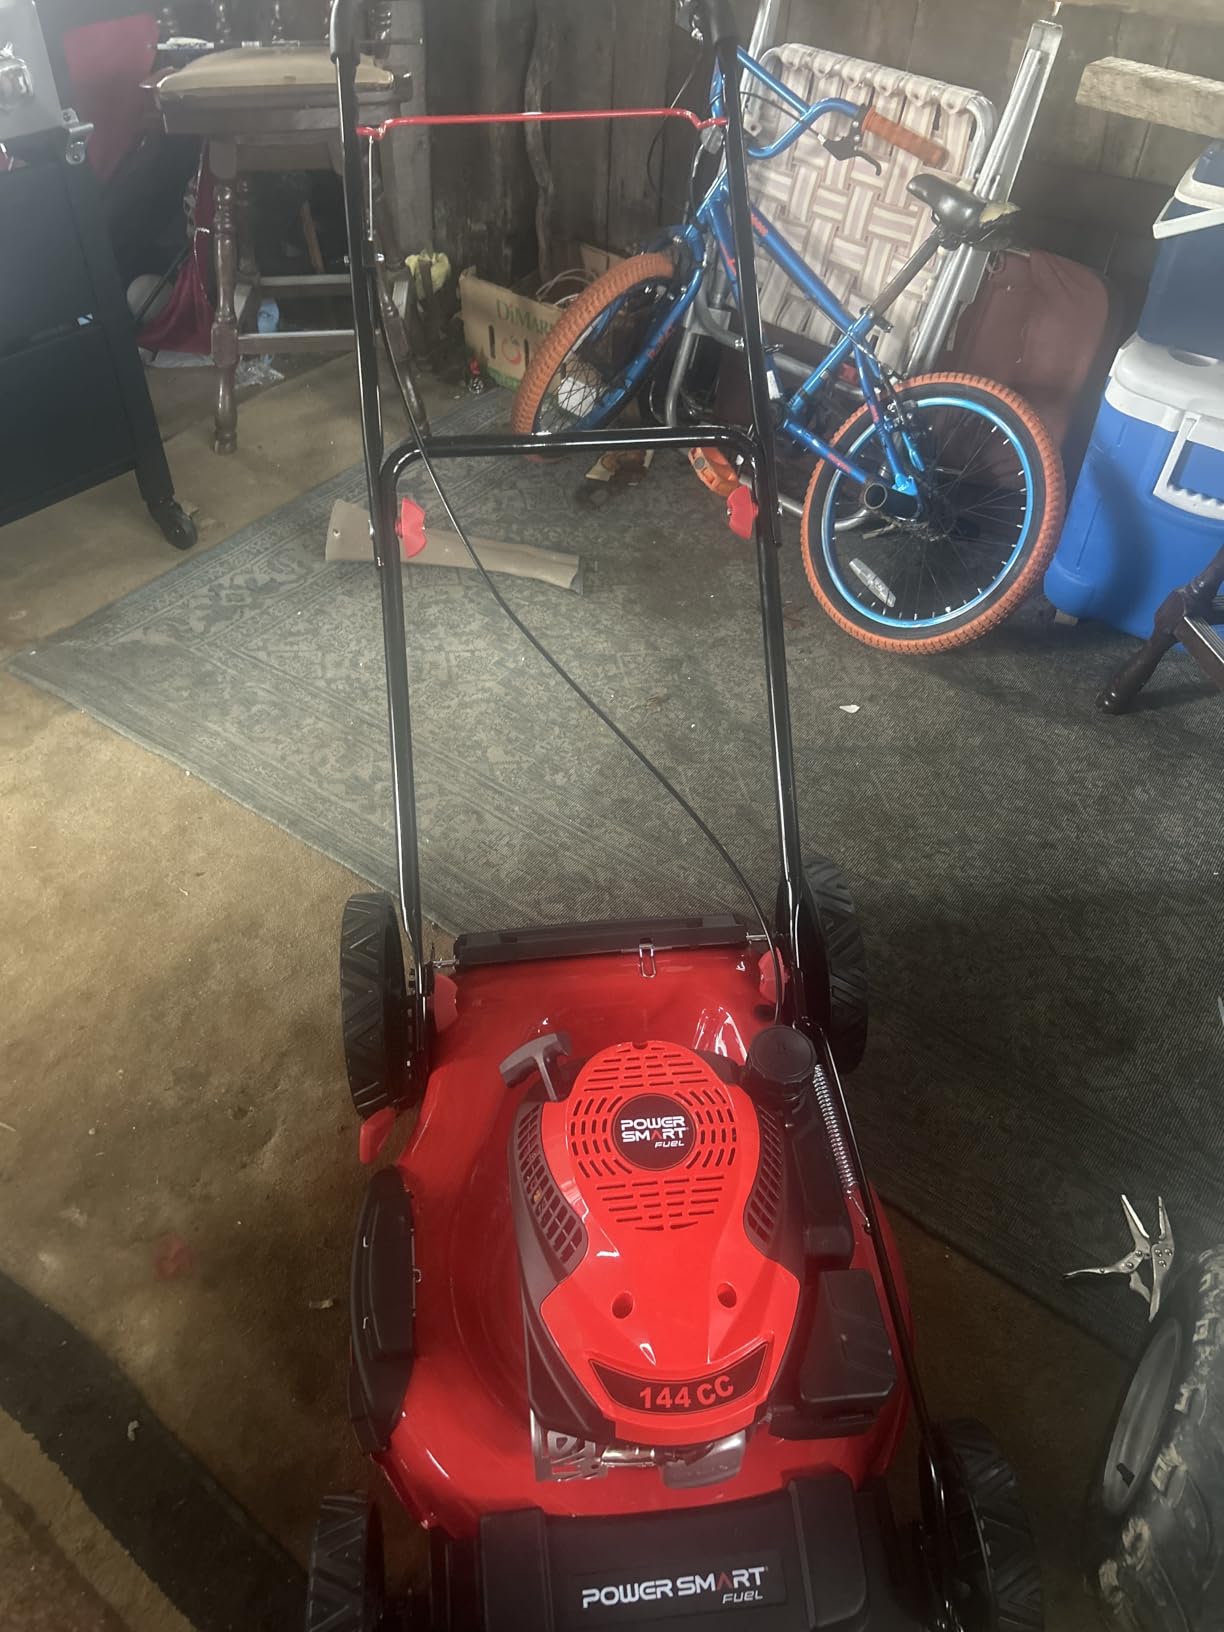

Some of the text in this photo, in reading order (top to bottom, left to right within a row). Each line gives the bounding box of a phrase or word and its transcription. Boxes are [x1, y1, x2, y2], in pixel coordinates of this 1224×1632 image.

[620, 1116, 686, 1131] POWER
[621, 1127, 686, 1143] SMART
[654, 1140, 685, 1149] FUEL
[640, 1375, 734, 1409] 144 CC
[582, 1566, 766, 1609] POWER SMART
[722, 1590, 764, 1605] FUEL
